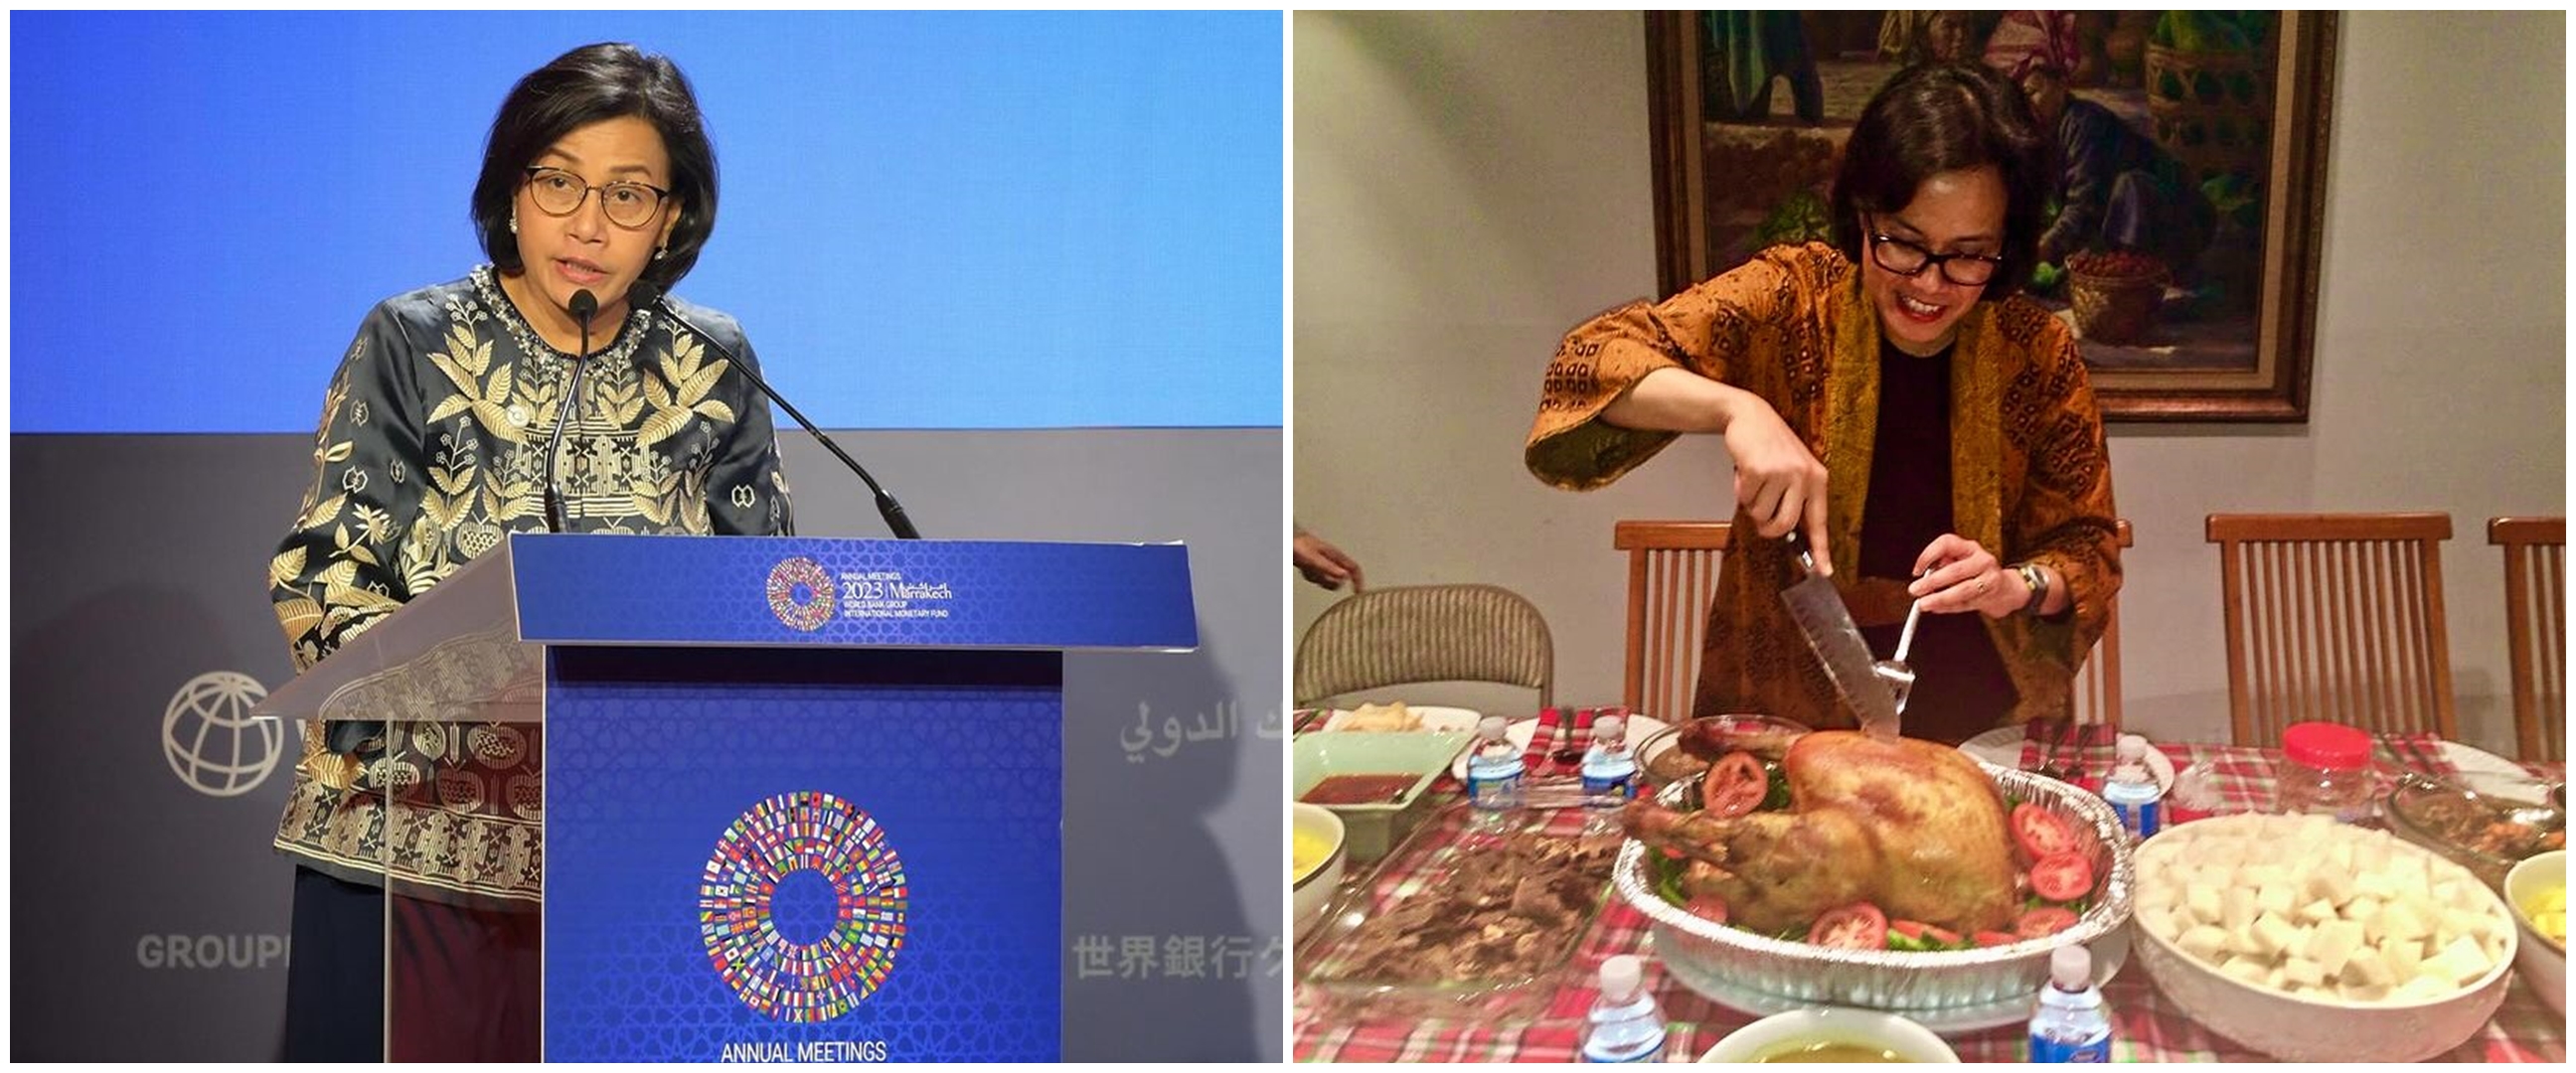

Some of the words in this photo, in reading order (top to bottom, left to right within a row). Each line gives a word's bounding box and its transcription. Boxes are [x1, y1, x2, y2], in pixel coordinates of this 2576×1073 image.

[842, 581, 884, 599] 2023
[889, 581, 952, 599] Marrakech
[844, 609, 892, 618] INTERNATIONAL
[893, 609, 929, 618] MONETARY
[930, 609, 949, 618] FUND
[1120, 700, 1238, 763] الدولي
[721, 1042, 793, 1063] ANNUAL
[797, 1040, 887, 1062] MEETINGS
